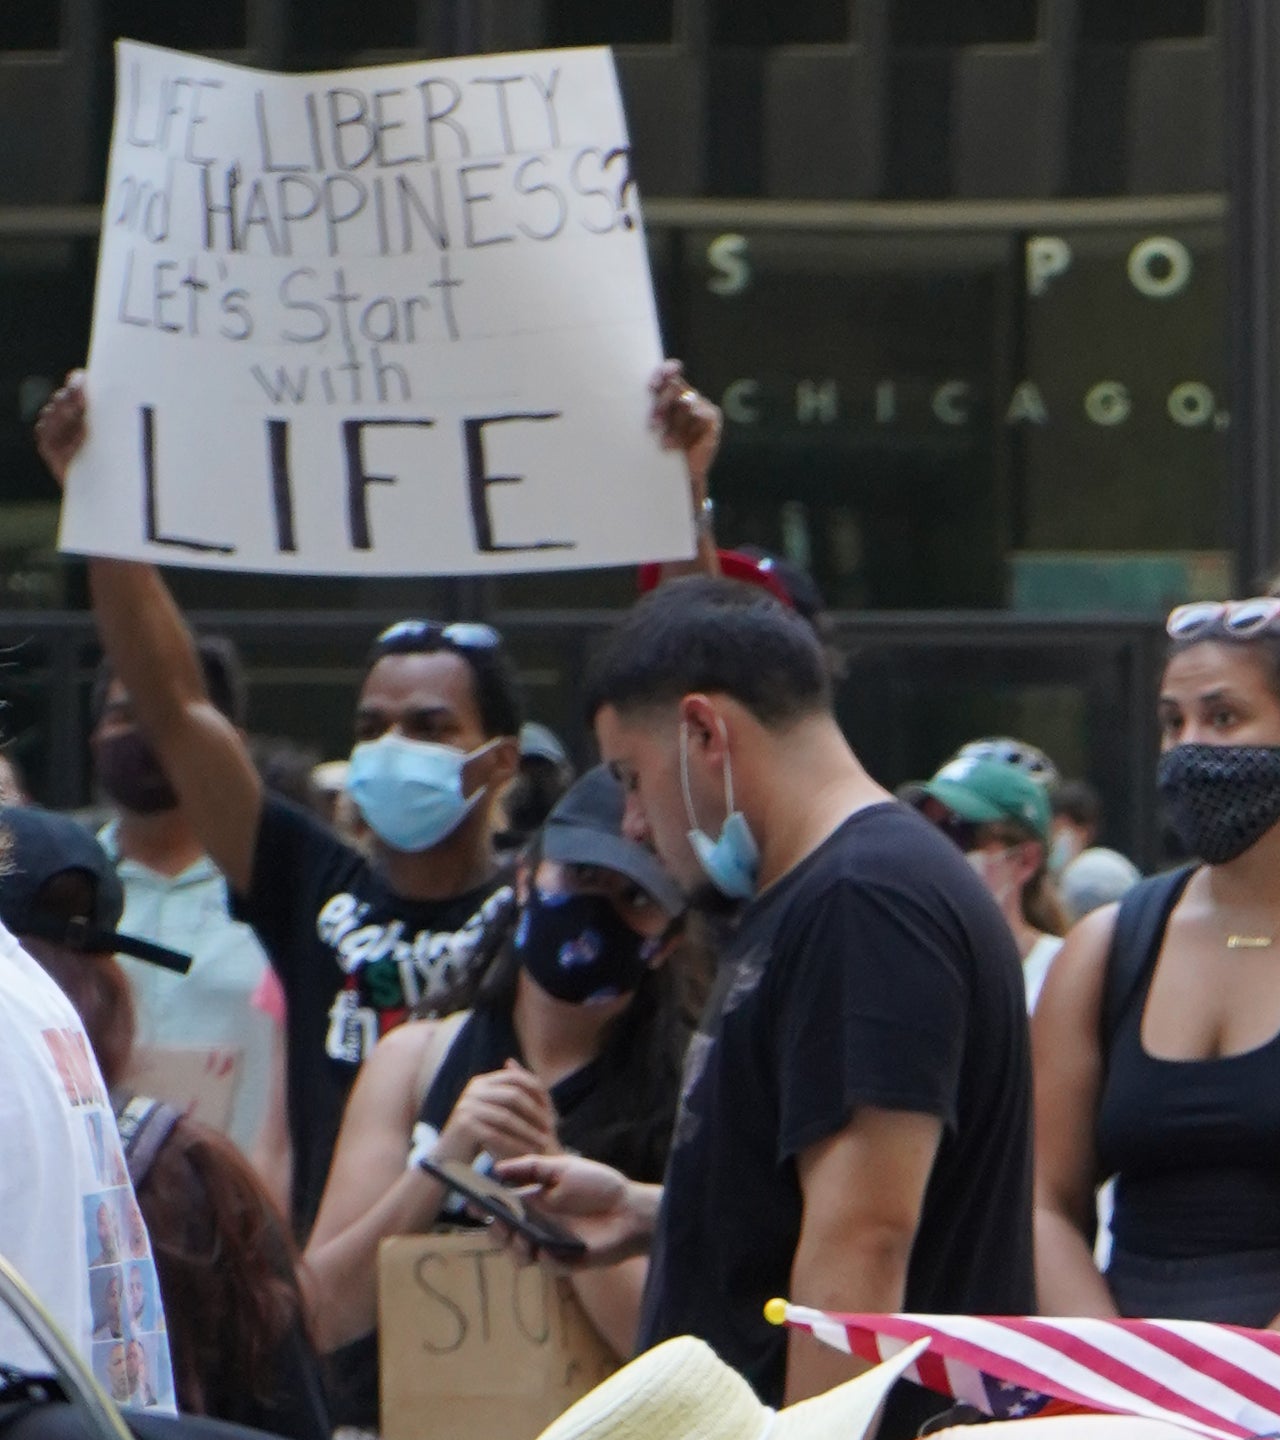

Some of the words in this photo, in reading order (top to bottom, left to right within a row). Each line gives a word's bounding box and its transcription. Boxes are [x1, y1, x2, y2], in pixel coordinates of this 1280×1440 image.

[252, 66, 562, 174] LIBERTY
[200, 145, 637, 257] HAPPINESS?
[278, 256, 464, 356] Start
[250, 346, 412, 405] with
[138, 404, 578, 553] LIFE
